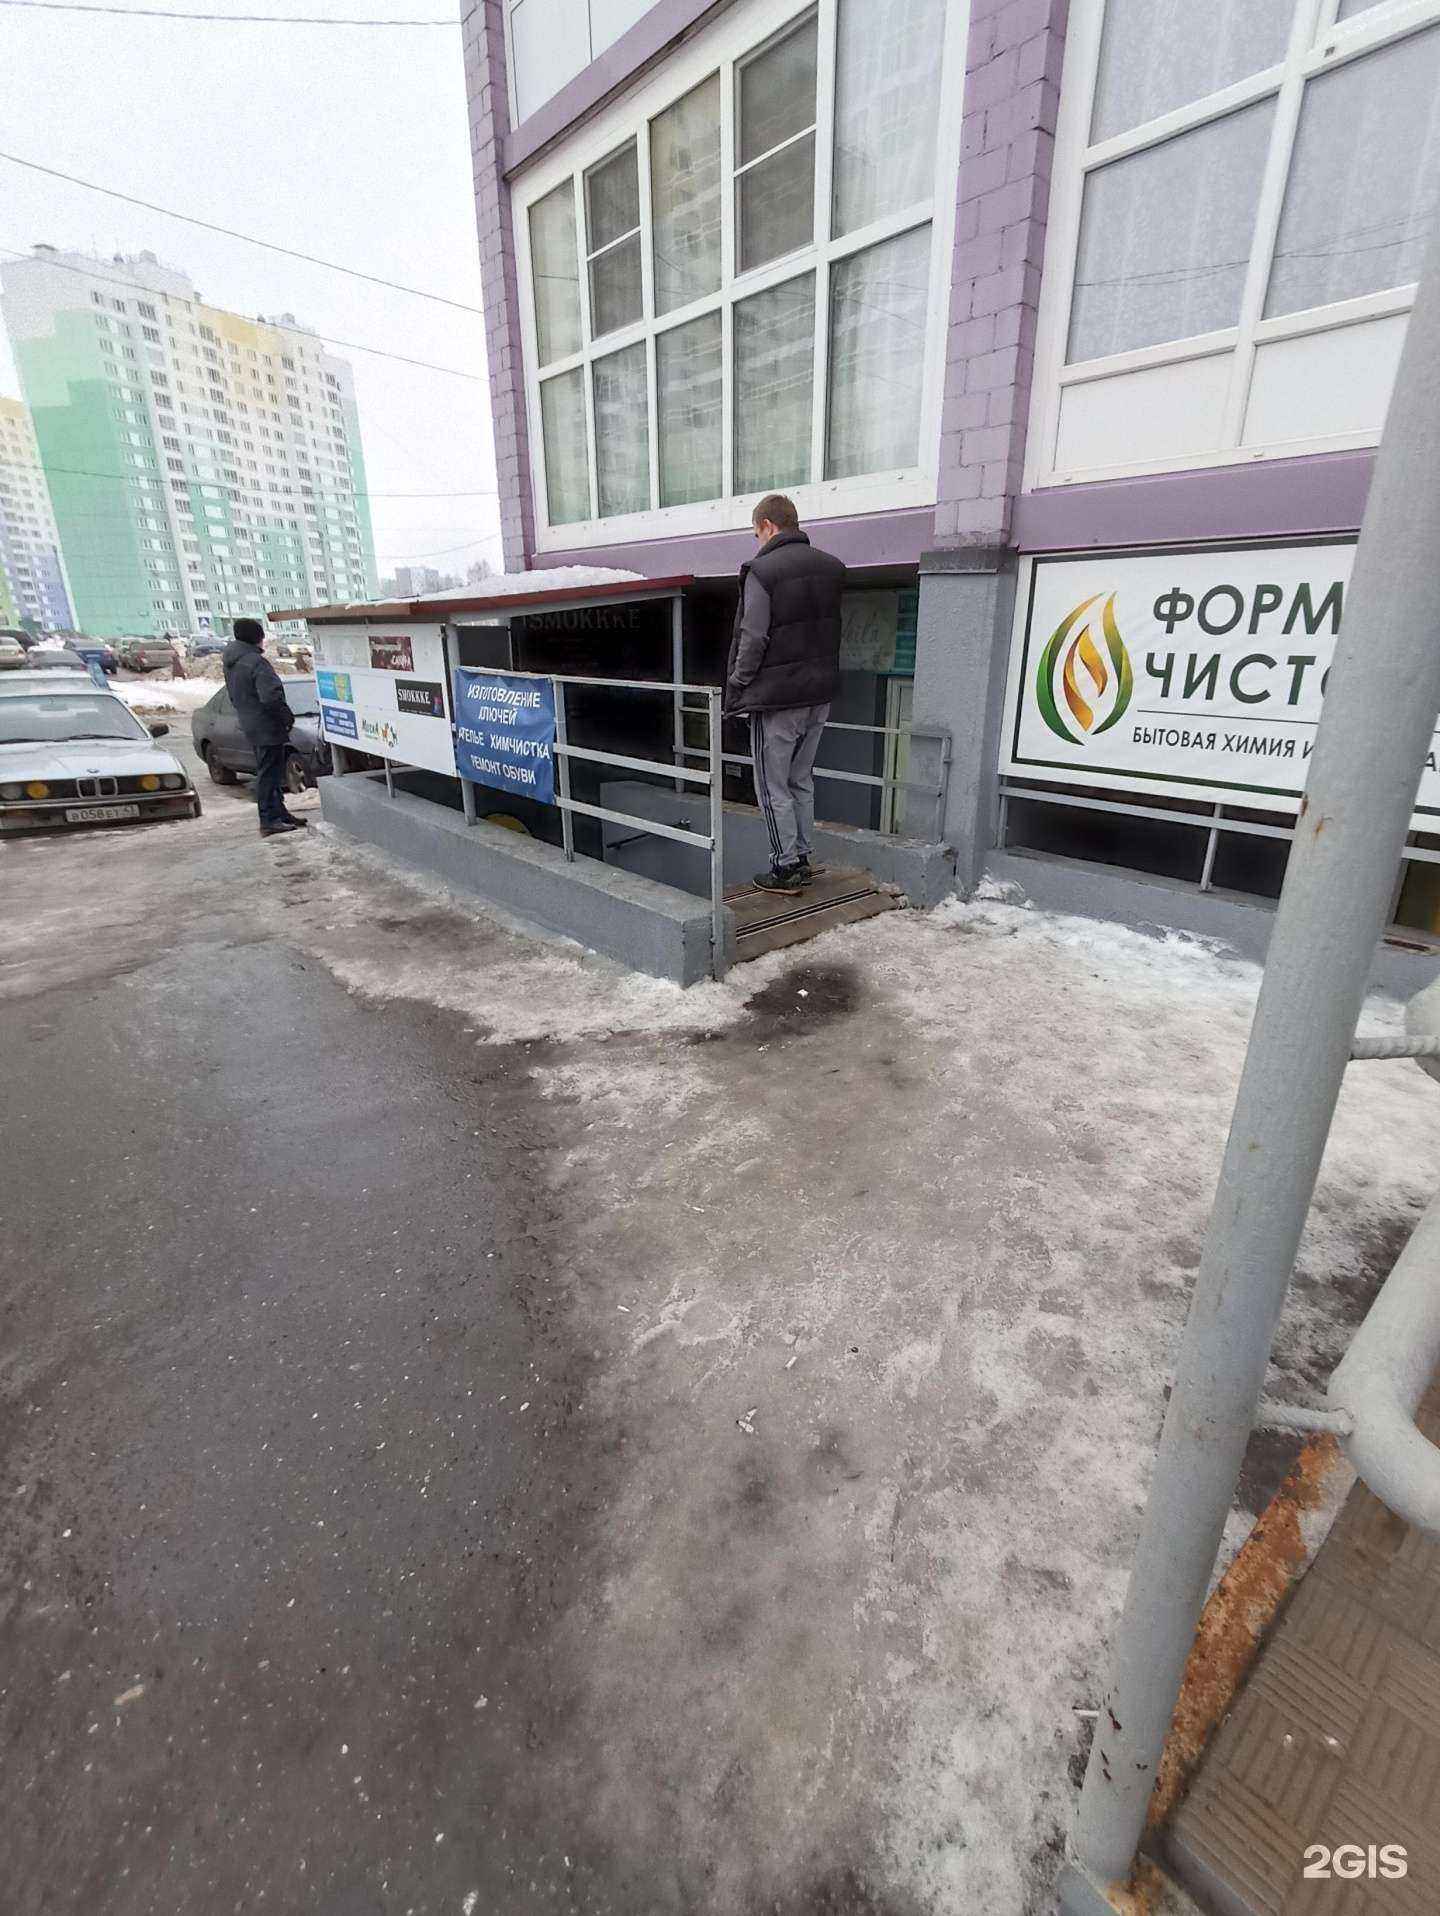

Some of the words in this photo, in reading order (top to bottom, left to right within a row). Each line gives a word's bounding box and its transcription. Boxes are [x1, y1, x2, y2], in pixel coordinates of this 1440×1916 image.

[1145, 652, 1332, 706] ЧИСТ
[467, 684, 541, 708] ИЗГОТОВЛЕНИЕ
[490, 733, 551, 760] ХИМЧИСТКА
[1132, 726, 1217, 750] БЫТОВАЯ
[1221, 734, 1297, 759] ХИМИЯ
[503, 765, 537, 785] ОБУВИ
